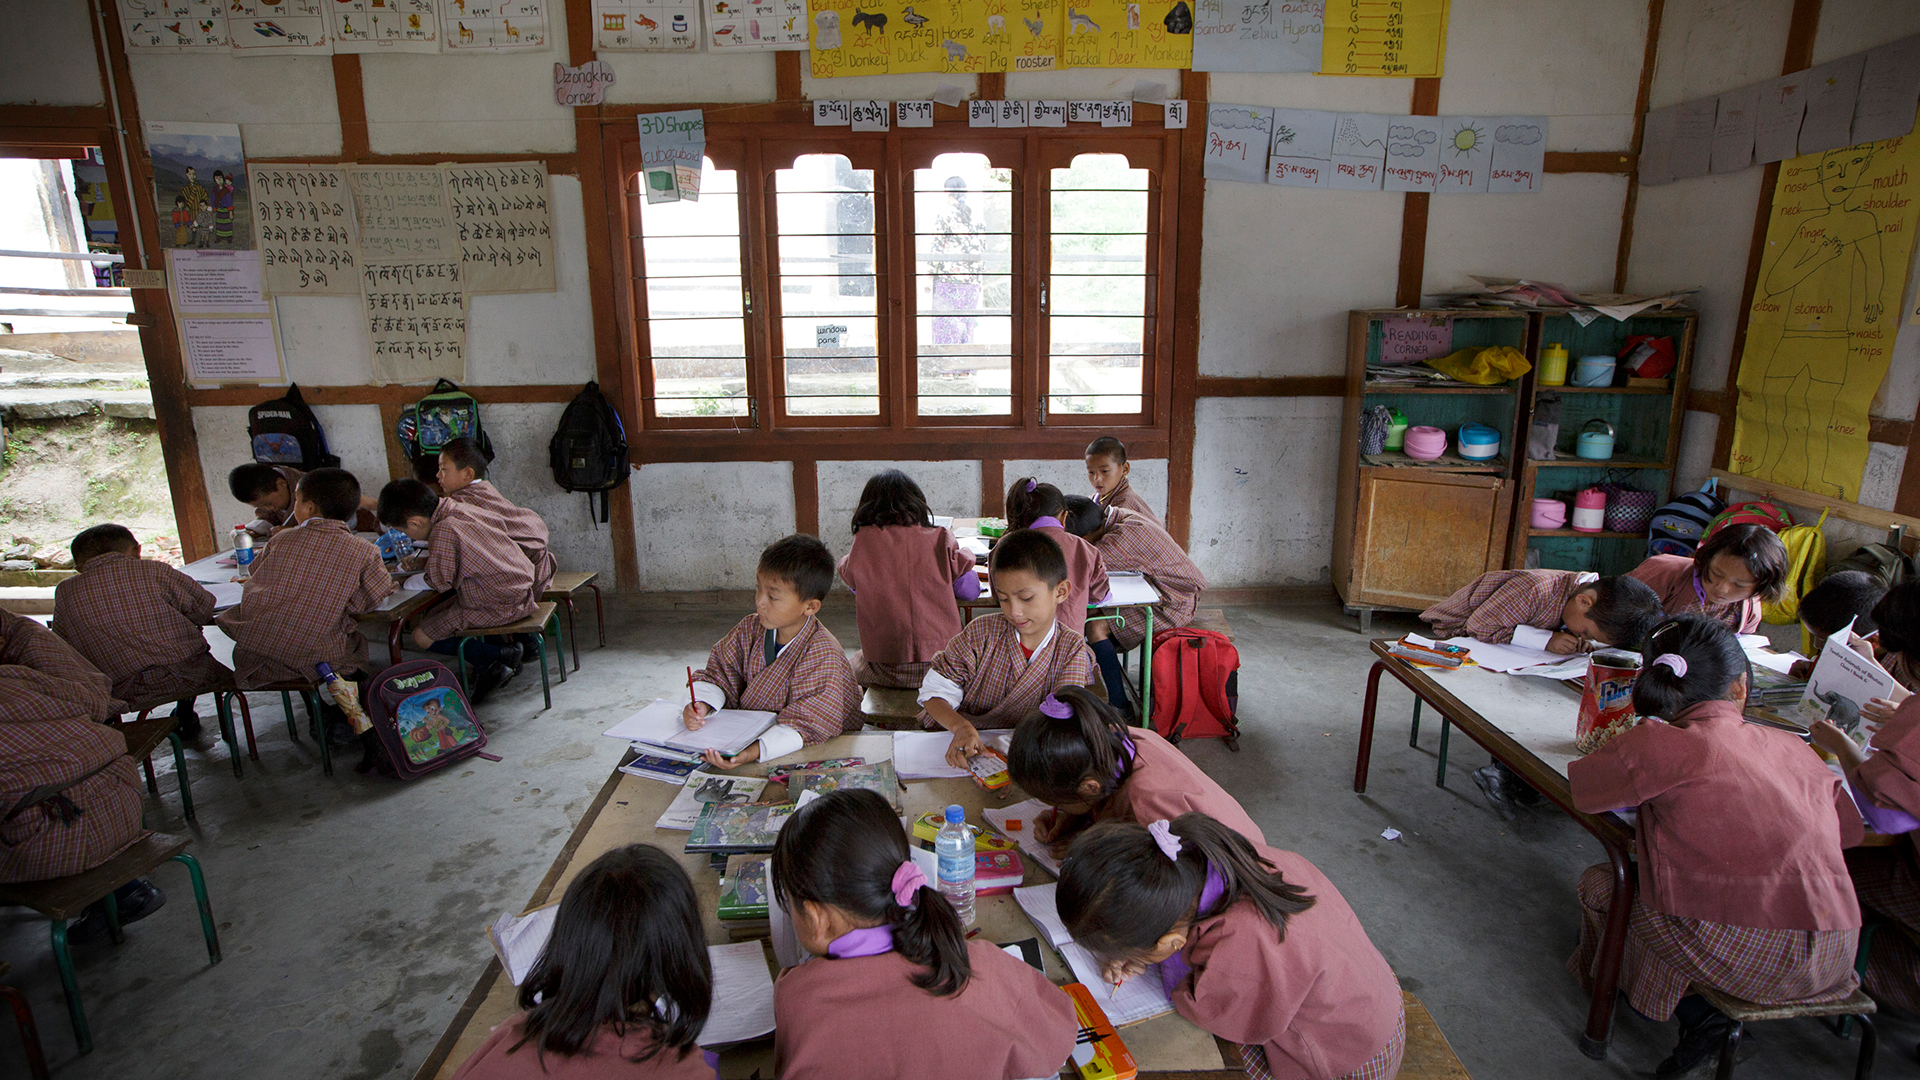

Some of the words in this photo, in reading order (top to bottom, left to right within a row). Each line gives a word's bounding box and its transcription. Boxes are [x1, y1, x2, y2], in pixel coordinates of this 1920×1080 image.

[1015, 55, 1054, 69] rooster
[555, 62, 614, 88] Dzongkha
[640, 116, 665, 135] 3-D
[666, 116, 704, 141] Shapes
[1885, 136, 1903, 154] eye
[1787, 168, 1802, 177] ear
[1872, 165, 1908, 190] mouth
[1783, 182, 1808, 194] nose
[1780, 201, 1802, 216] neck
[1863, 192, 1911, 210] shoulder
[1884, 219, 1903, 233] nail
[1799, 227, 1826, 244] finger
[1753, 299, 1781, 312] elbow
[1794, 299, 1833, 314] stomach
[1389, 328, 1437, 341] READING
[1855, 326, 1884, 339] waist
[1394, 344, 1429, 354] CORNER
[1859, 344, 1883, 361] hips
[1834, 420, 1855, 435] knee
[1732, 450, 1753, 463] toes
